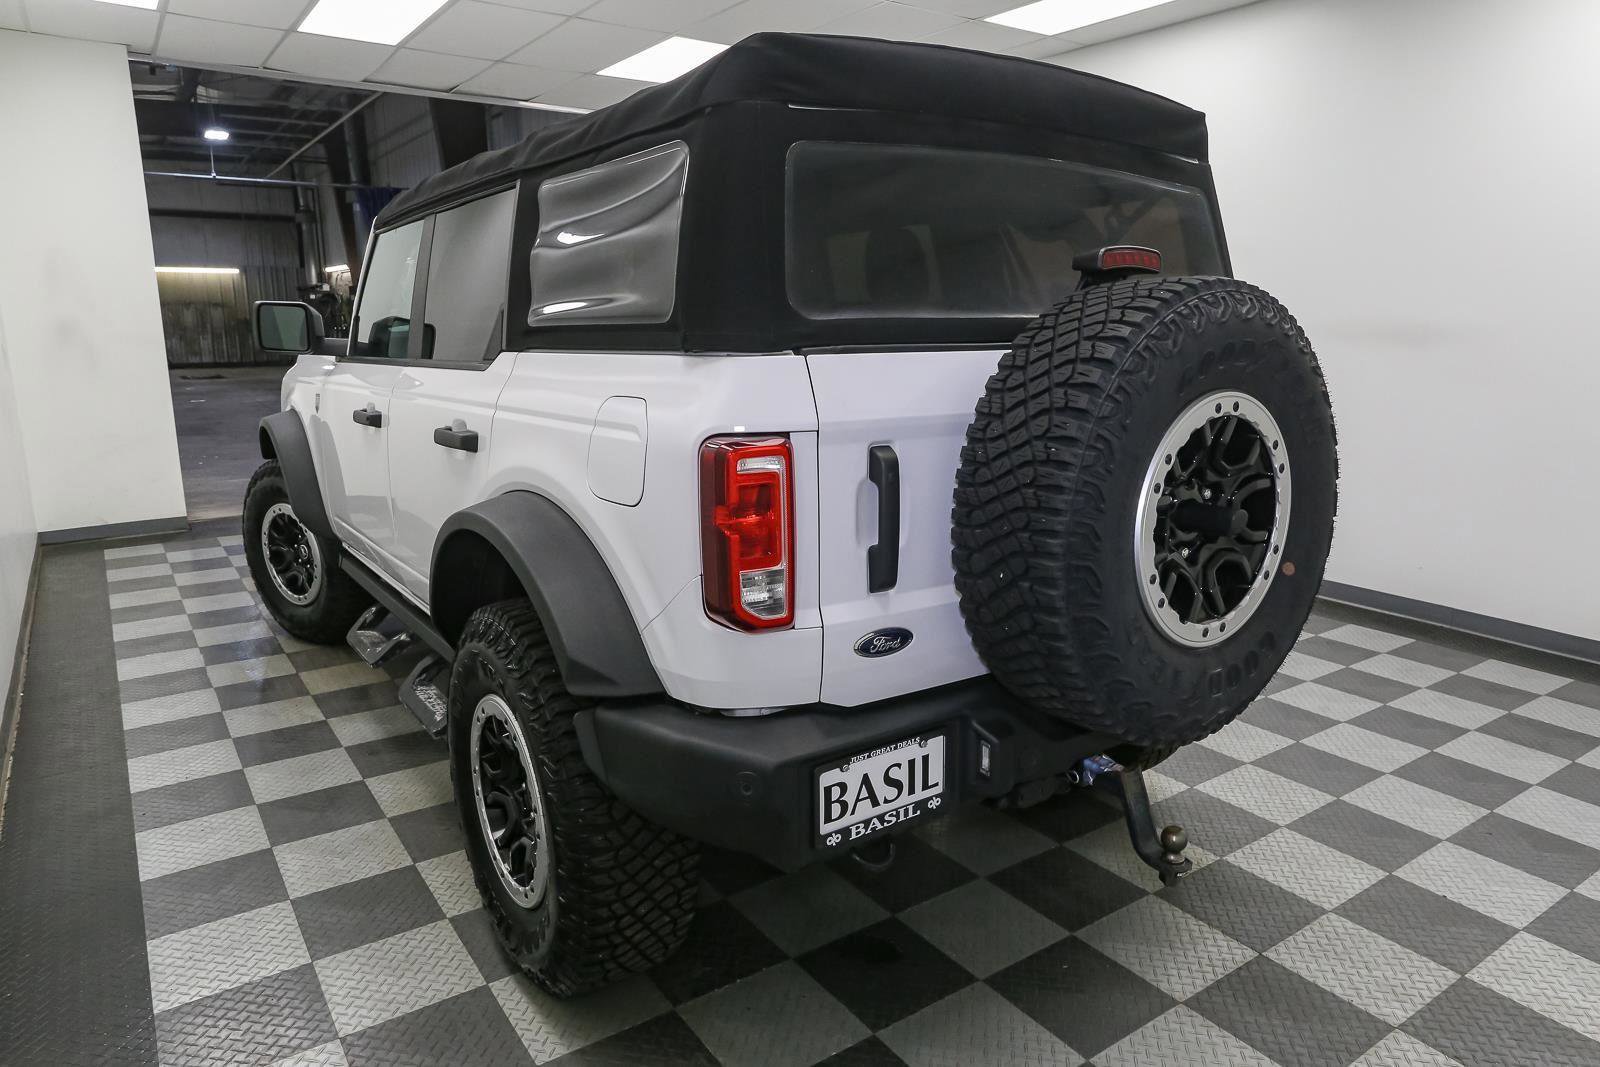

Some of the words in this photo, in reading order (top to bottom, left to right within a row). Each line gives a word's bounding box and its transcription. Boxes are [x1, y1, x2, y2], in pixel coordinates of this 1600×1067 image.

[870, 636, 901, 653] Ford
[850, 753, 870, 764] JUST
[870, 745, 896, 758] GREAT
[897, 737, 920, 749] DEALS
[823, 753, 940, 825] BASIL
[849, 804, 921, 841] BASIL
